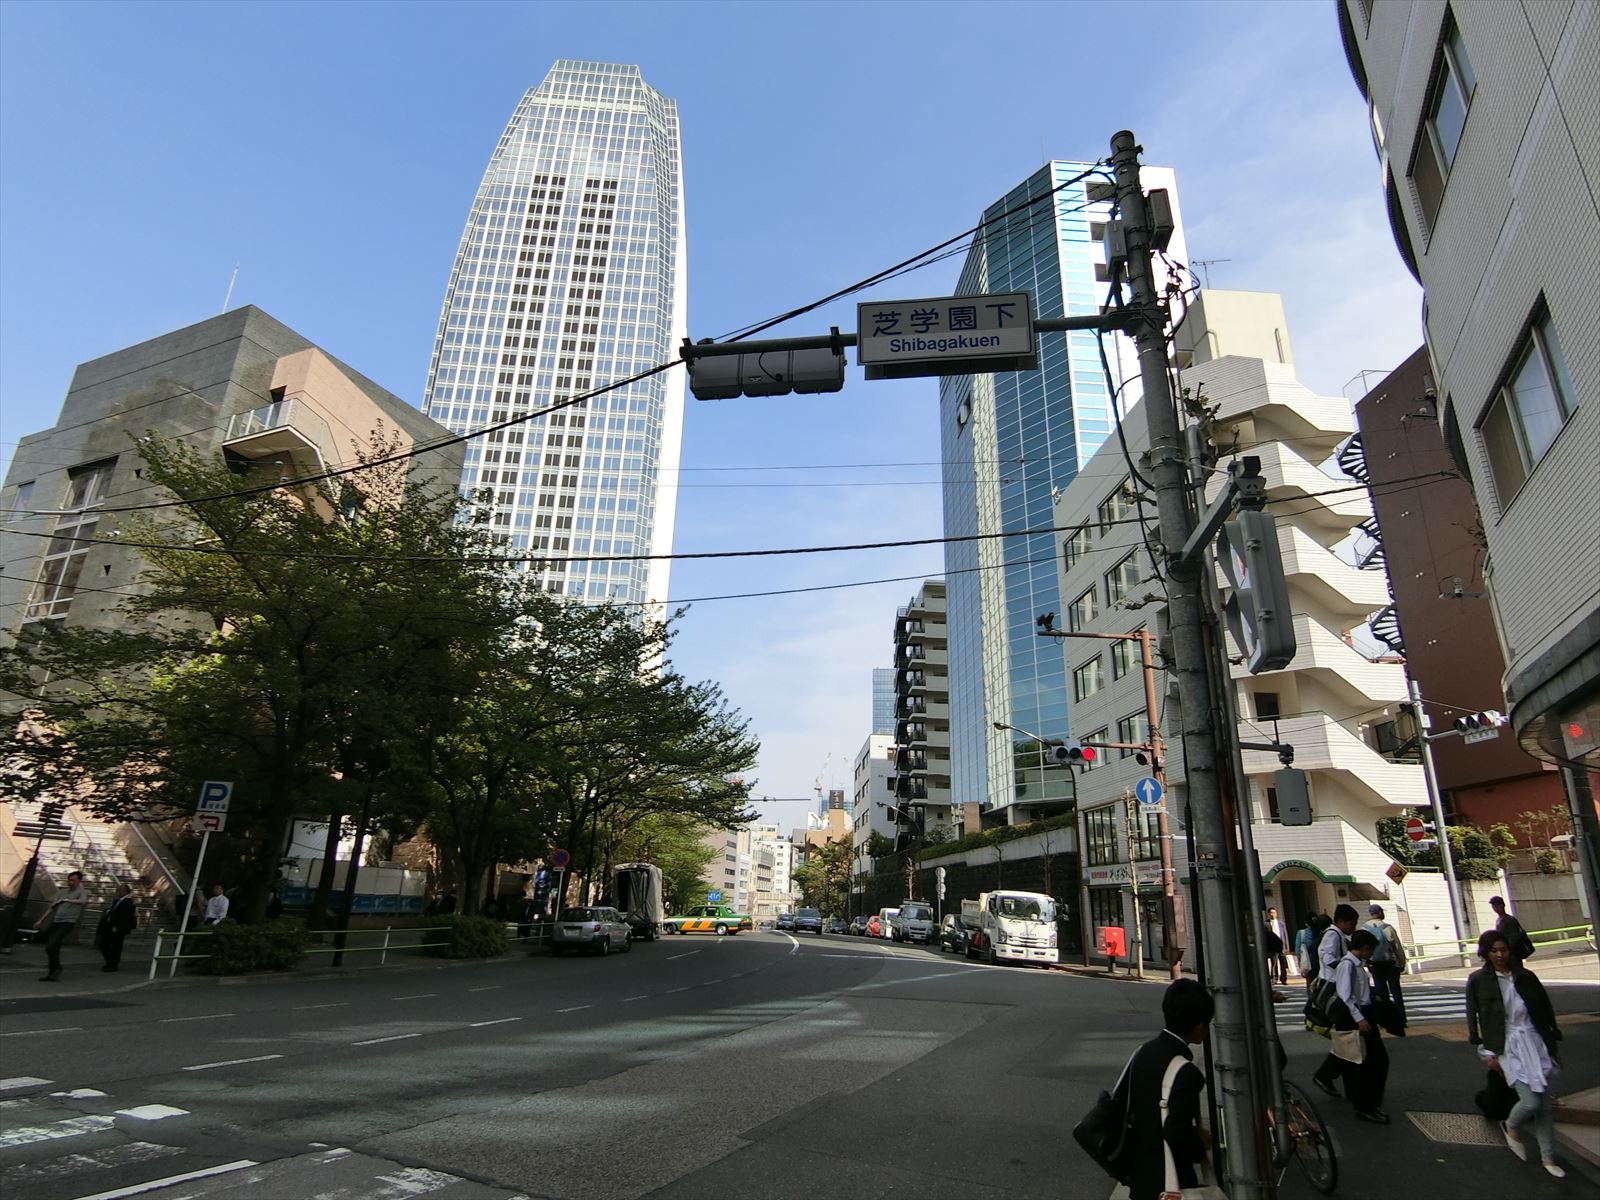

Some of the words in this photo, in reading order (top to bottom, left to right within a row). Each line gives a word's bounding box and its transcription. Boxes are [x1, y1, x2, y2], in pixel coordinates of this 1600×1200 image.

[872, 302, 1016, 337] 芝学園下
[889, 334, 1001, 353] Shibagakuen
[200, 783, 229, 809] P
